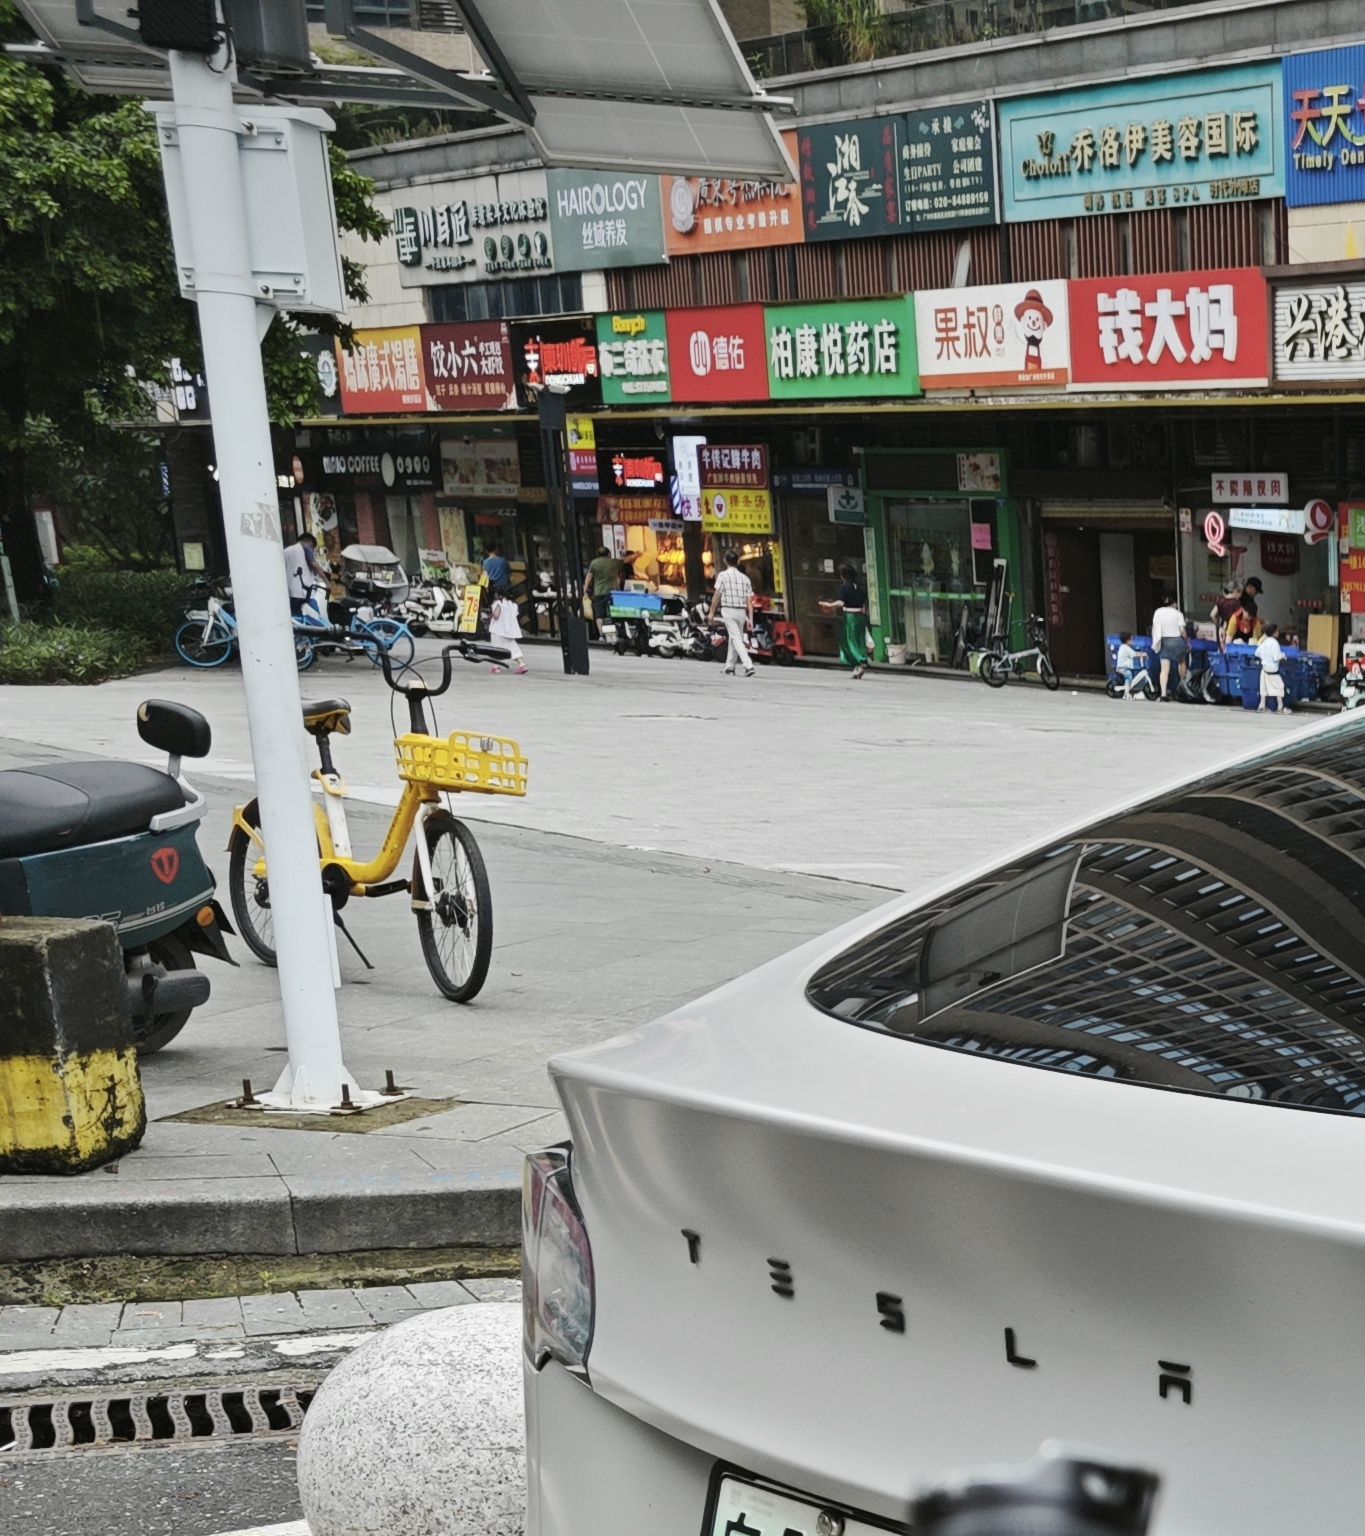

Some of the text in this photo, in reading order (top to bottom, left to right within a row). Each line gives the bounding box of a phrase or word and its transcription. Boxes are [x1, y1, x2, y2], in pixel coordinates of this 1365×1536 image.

[1072, 112, 1258, 171] 乔洛伊美容国际
[1293, 151, 1334, 171] Timely
[557, 180, 648, 217] HAIROLOGY
[581, 217, 628, 249] 丝域养发
[934, 306, 991, 360] 果叔
[1098, 284, 1238, 365] 钱大妈
[430, 339, 478, 379] 饺小六
[713, 335, 744, 371] 德佑
[770, 319, 897, 378] 柏康悦药店
[348, 455, 380, 474] COFFEE
[680, 1227, 1193, 1405] TESLA
